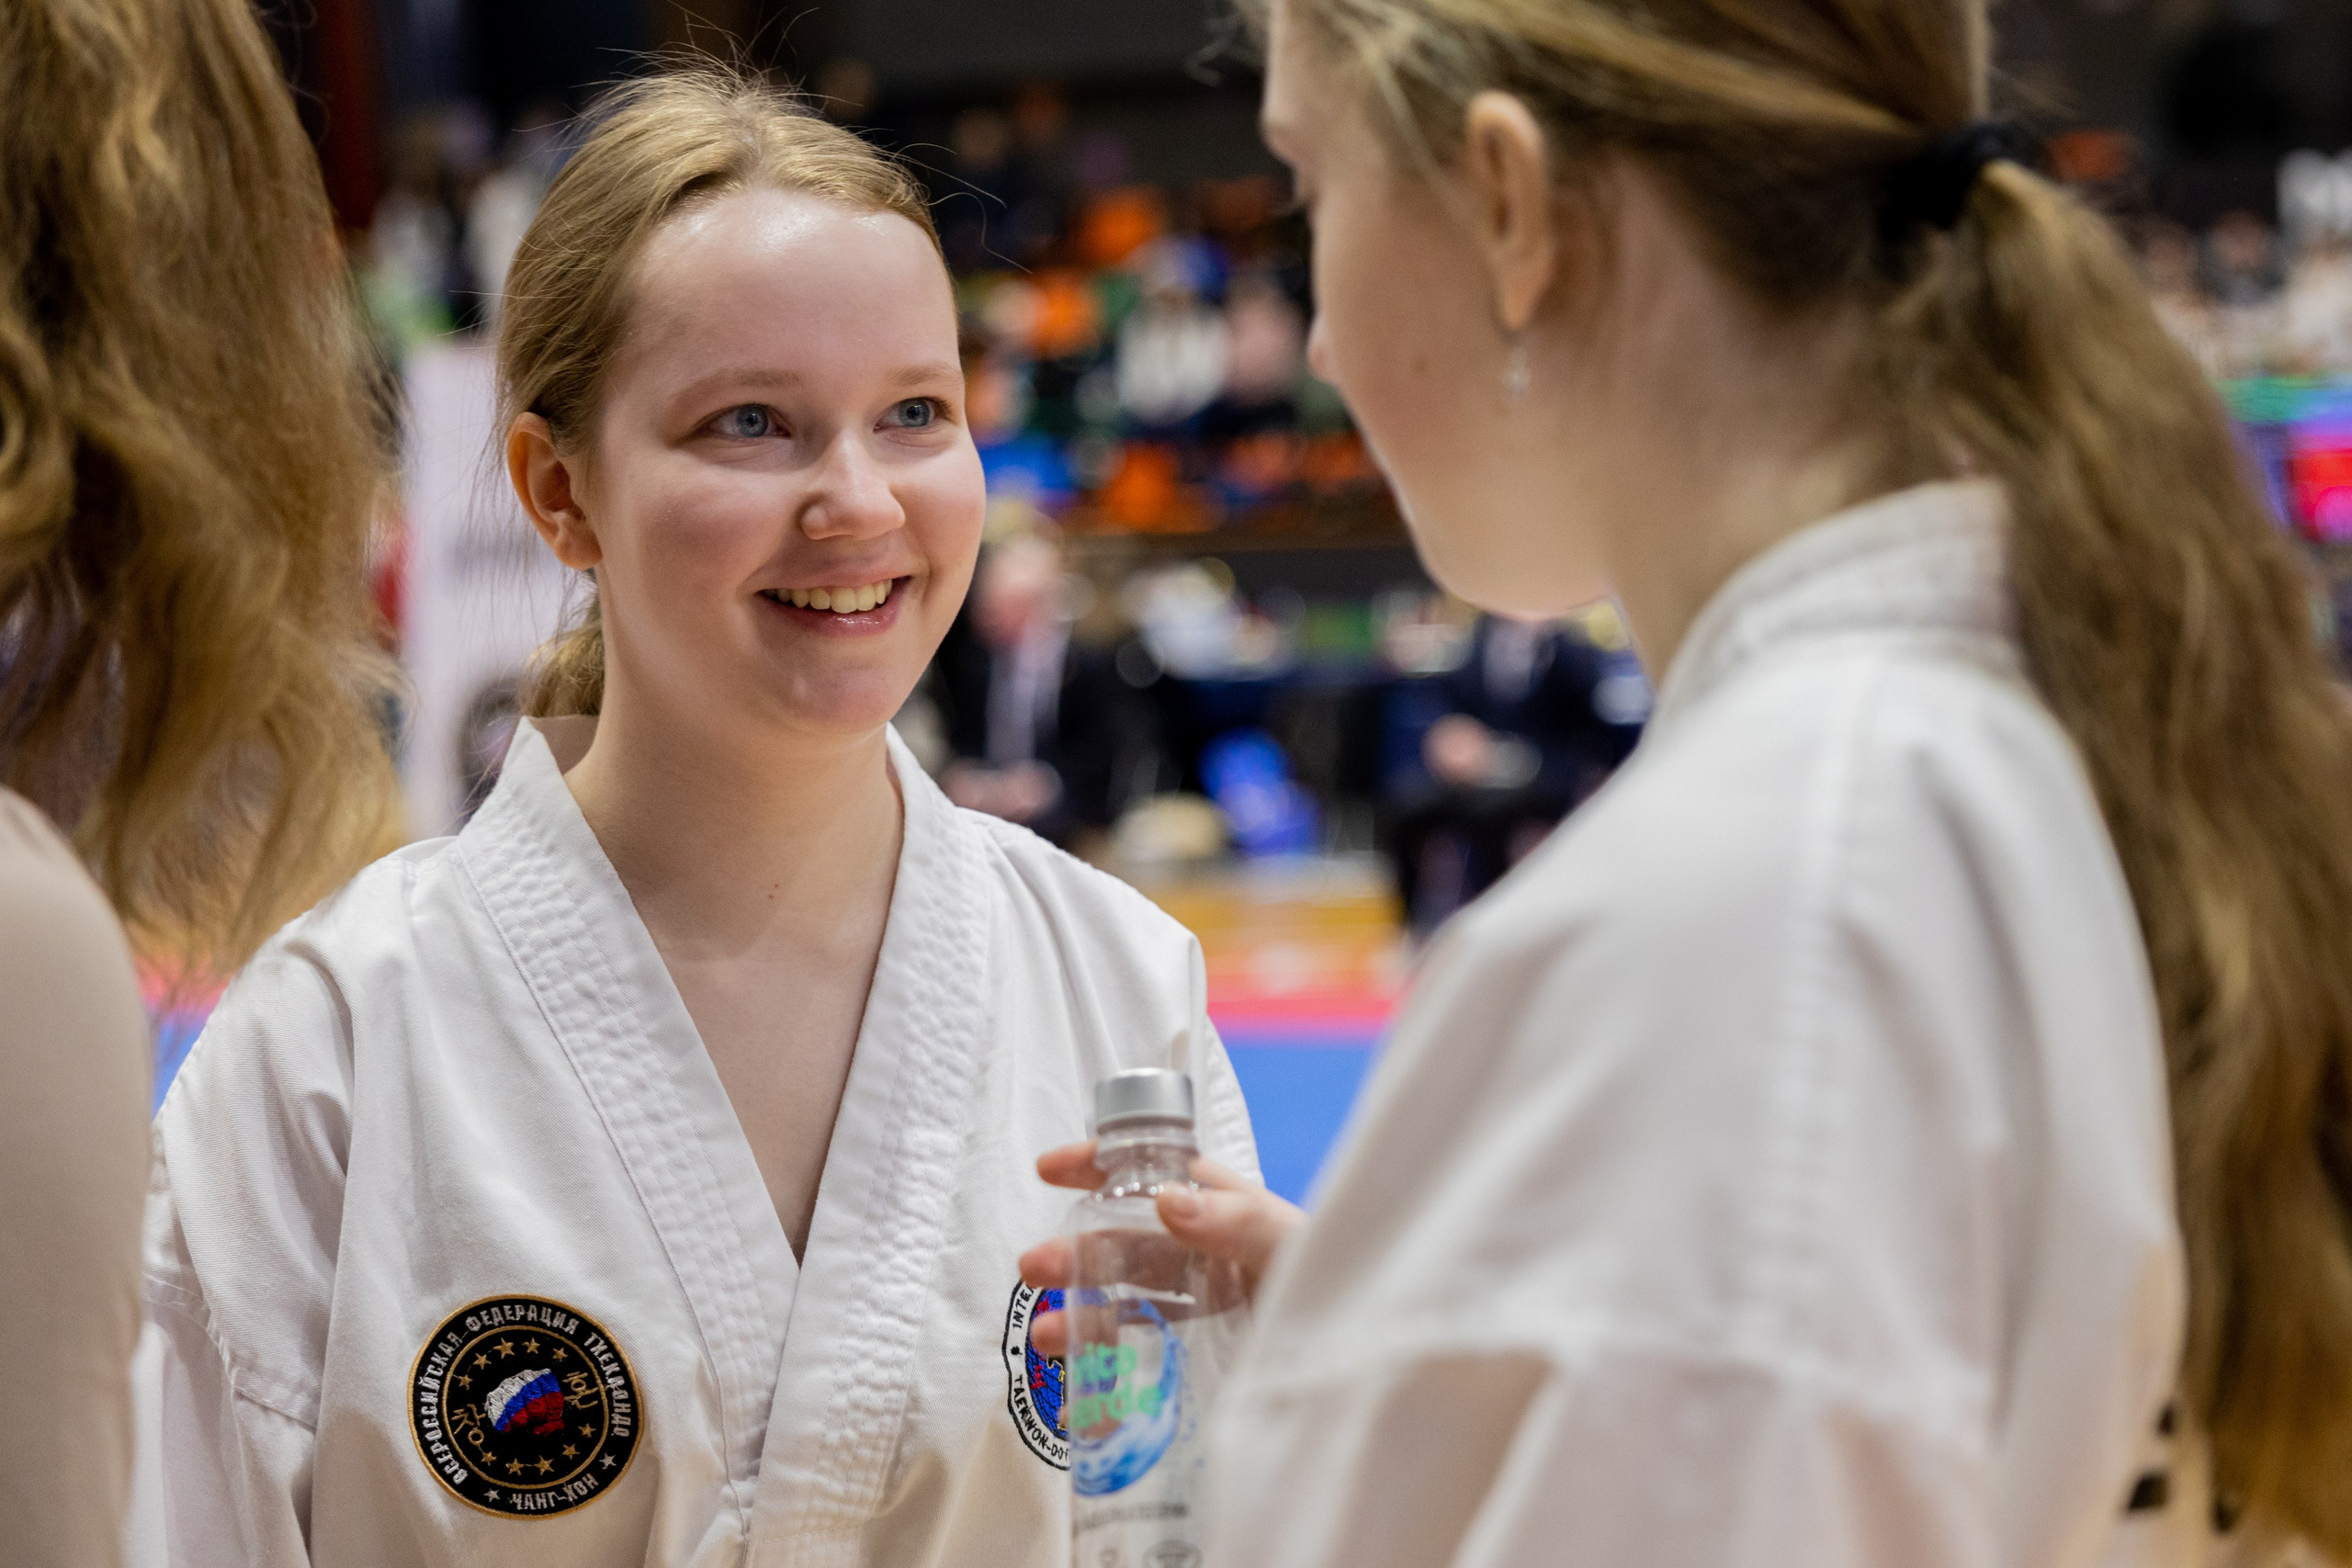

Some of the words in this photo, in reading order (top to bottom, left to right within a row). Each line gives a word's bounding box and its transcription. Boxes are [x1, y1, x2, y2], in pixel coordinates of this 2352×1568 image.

[1012, 1287, 1035, 1329] INTE
[418, 1330, 469, 1485] ВСЕРОССИЙСКАЯ
[465, 1304, 581, 1336] ФЕДЕРАЦИЯ
[511, 1472, 600, 1511] ЧАНГ-ХОН
